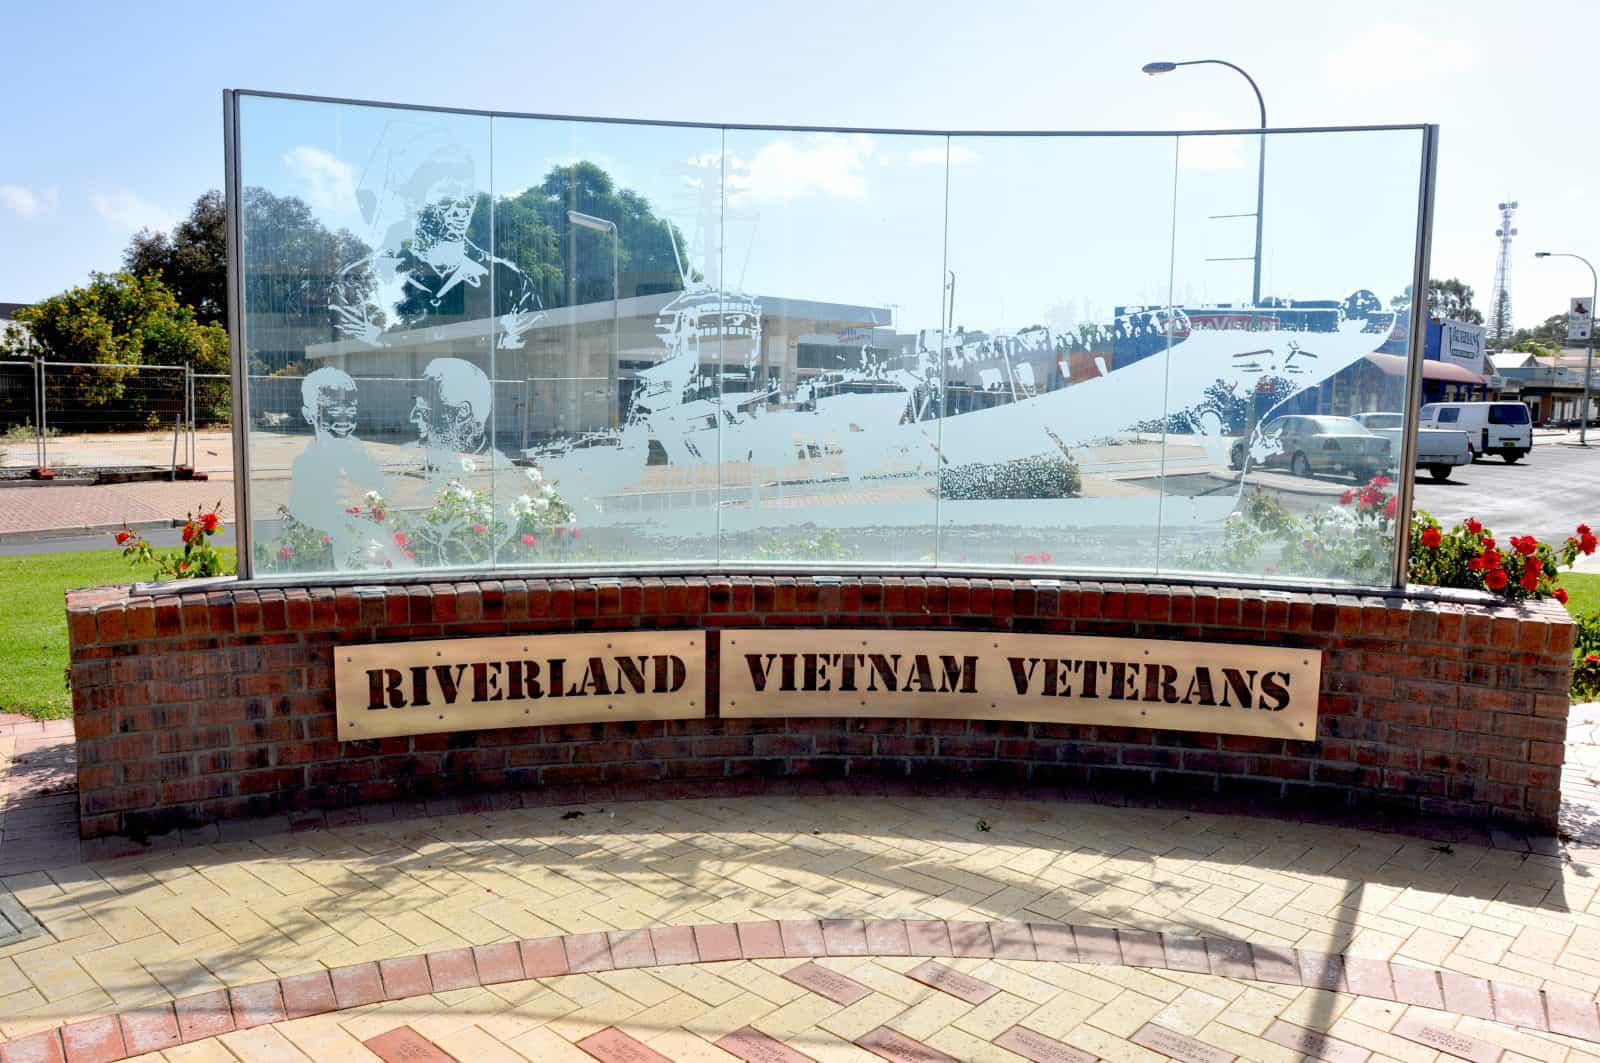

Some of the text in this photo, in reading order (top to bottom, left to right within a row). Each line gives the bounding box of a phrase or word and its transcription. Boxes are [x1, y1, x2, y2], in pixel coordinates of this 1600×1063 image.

[366, 653, 1291, 711] RIVERLAND VIETNAM VETERANS
